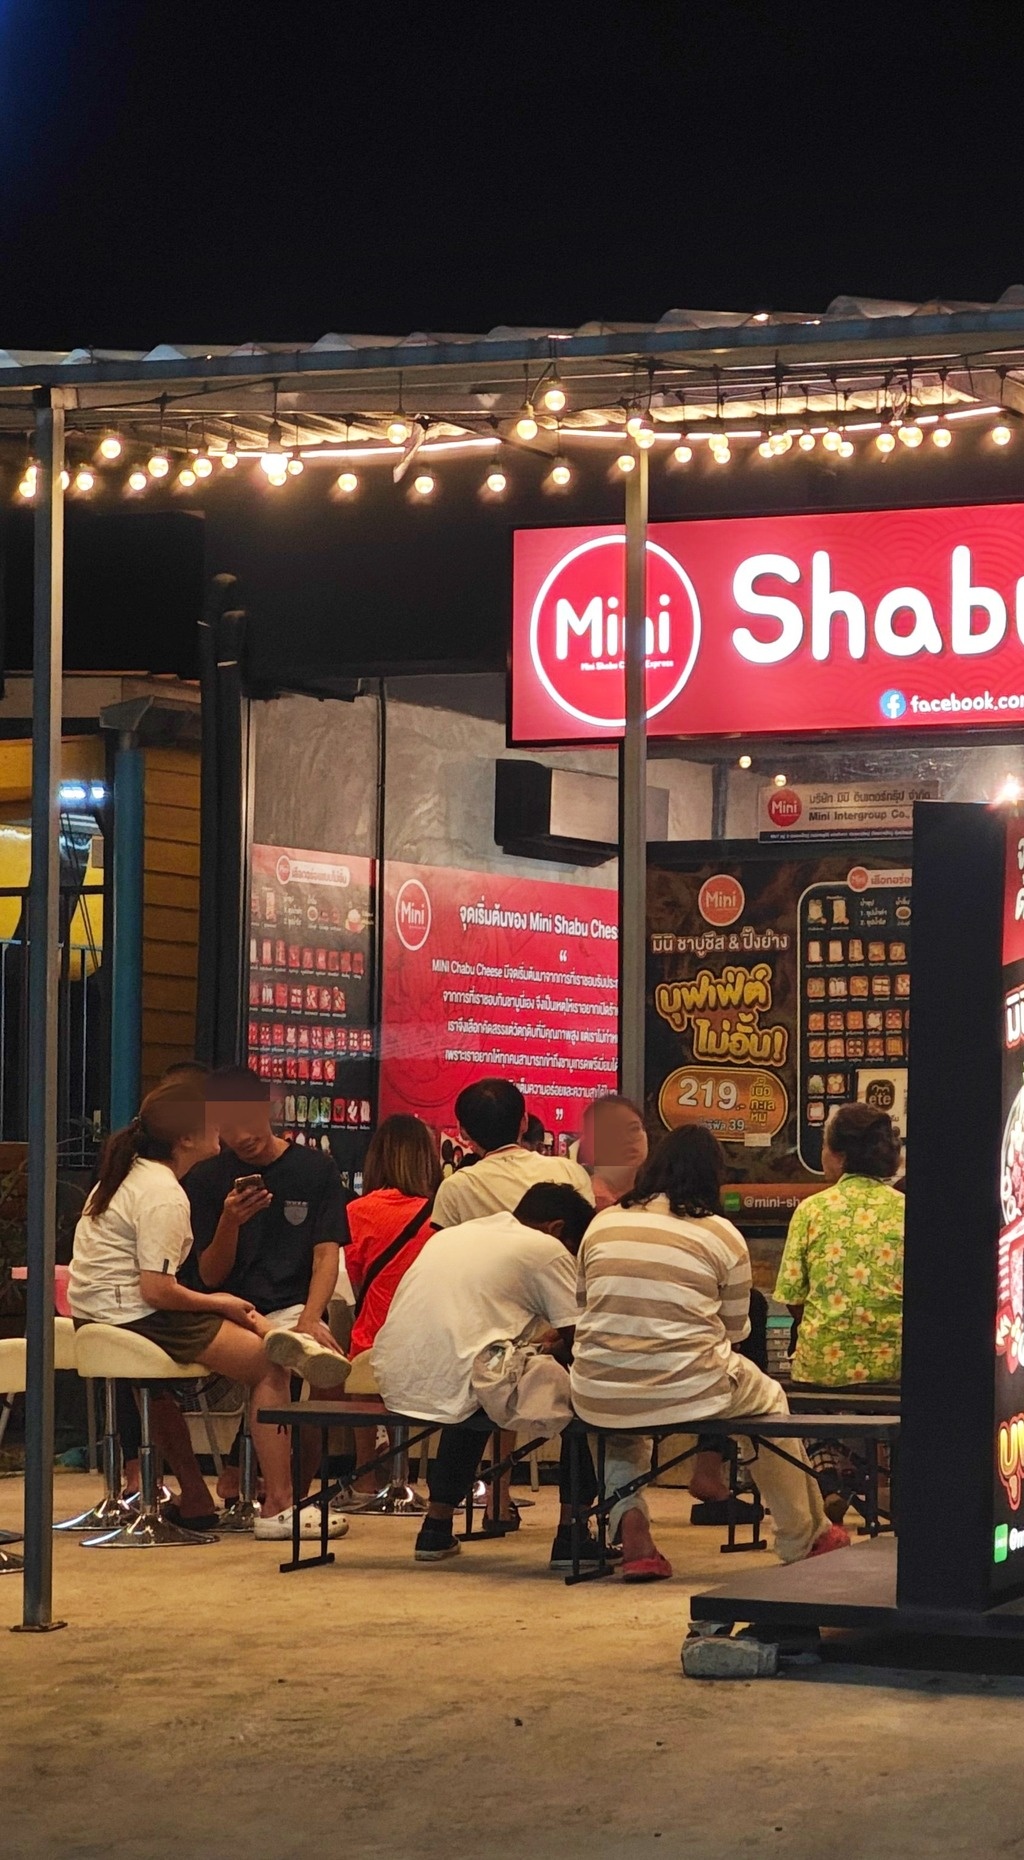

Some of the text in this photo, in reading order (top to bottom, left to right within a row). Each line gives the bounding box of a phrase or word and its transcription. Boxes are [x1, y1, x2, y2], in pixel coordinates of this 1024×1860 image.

[771, 800, 798, 815] Mini
[808, 811, 831, 822] Mini
[834, 808, 888, 822] Intergroup
[870, 873, 912, 886] เลือกอร่อ
[705, 890, 737, 908] Mini
[401, 900, 425, 925] Mini
[529, 911, 553, 933] Mini
[554, 914, 589, 938] Shabu
[590, 918, 619, 941] Ches
[652, 927, 788, 957] มินิ ชาบูชีส & ปิ้งย่าง
[432, 958, 451, 973] MINI
[451, 961, 476, 977] Chabu
[476, 963, 503, 978] Cheese
[743, 1196, 801, 1208] @mini-sh
